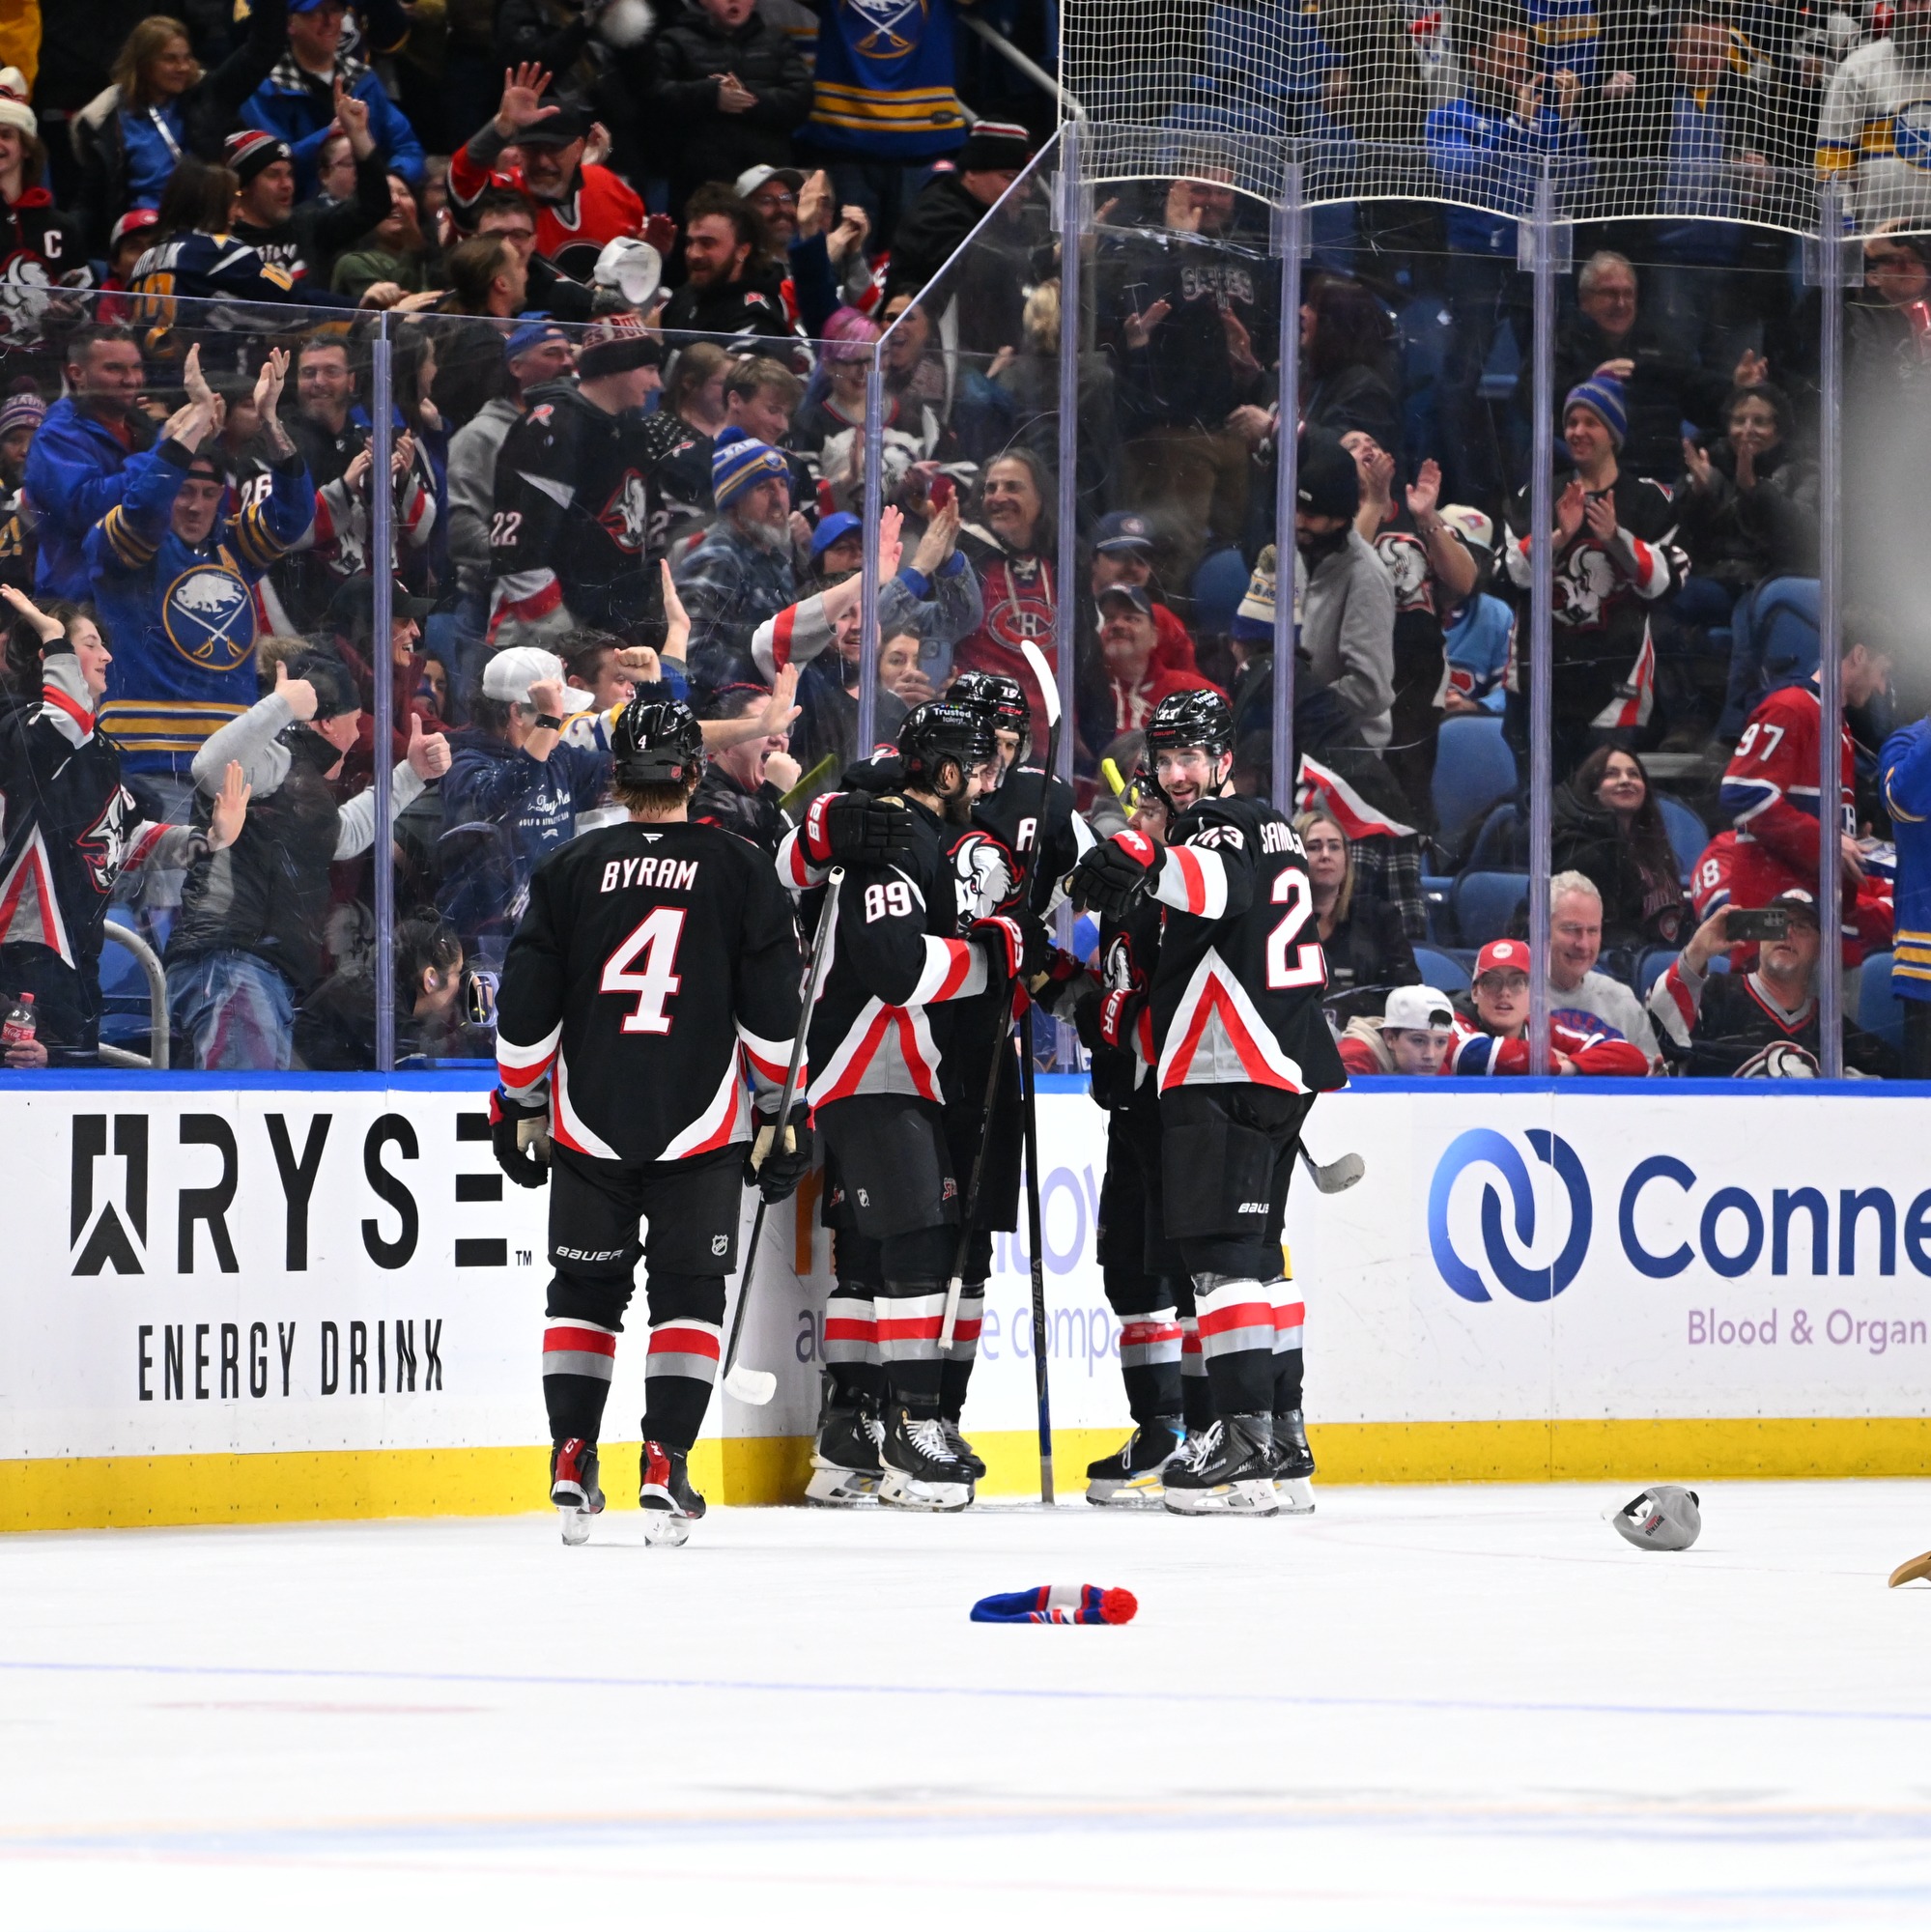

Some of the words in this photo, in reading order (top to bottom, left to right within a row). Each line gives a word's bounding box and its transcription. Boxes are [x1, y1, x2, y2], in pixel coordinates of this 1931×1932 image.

[44, 230, 62, 258] C
[490, 511, 523, 547] 22
[933, 707, 972, 718] Trusted
[638, 734, 647, 750] 4
[1735, 723, 1785, 762] 97
[1015, 817, 1037, 851] A
[600, 857, 699, 893] BYRAM
[864, 880, 914, 923] 89
[1266, 866, 1328, 991] 2
[598, 905, 688, 1036] 4
[179, 1114, 507, 1273] RYSE
[515, 1250, 532, 1265] TM
[1689, 1307, 1777, 1346] Blood
[1791, 1308, 1814, 1346] &
[1827, 1308, 1928, 1356] Organ
[139, 1321, 296, 1401] ENERGY
[322, 1320, 442, 1396] DRINK
